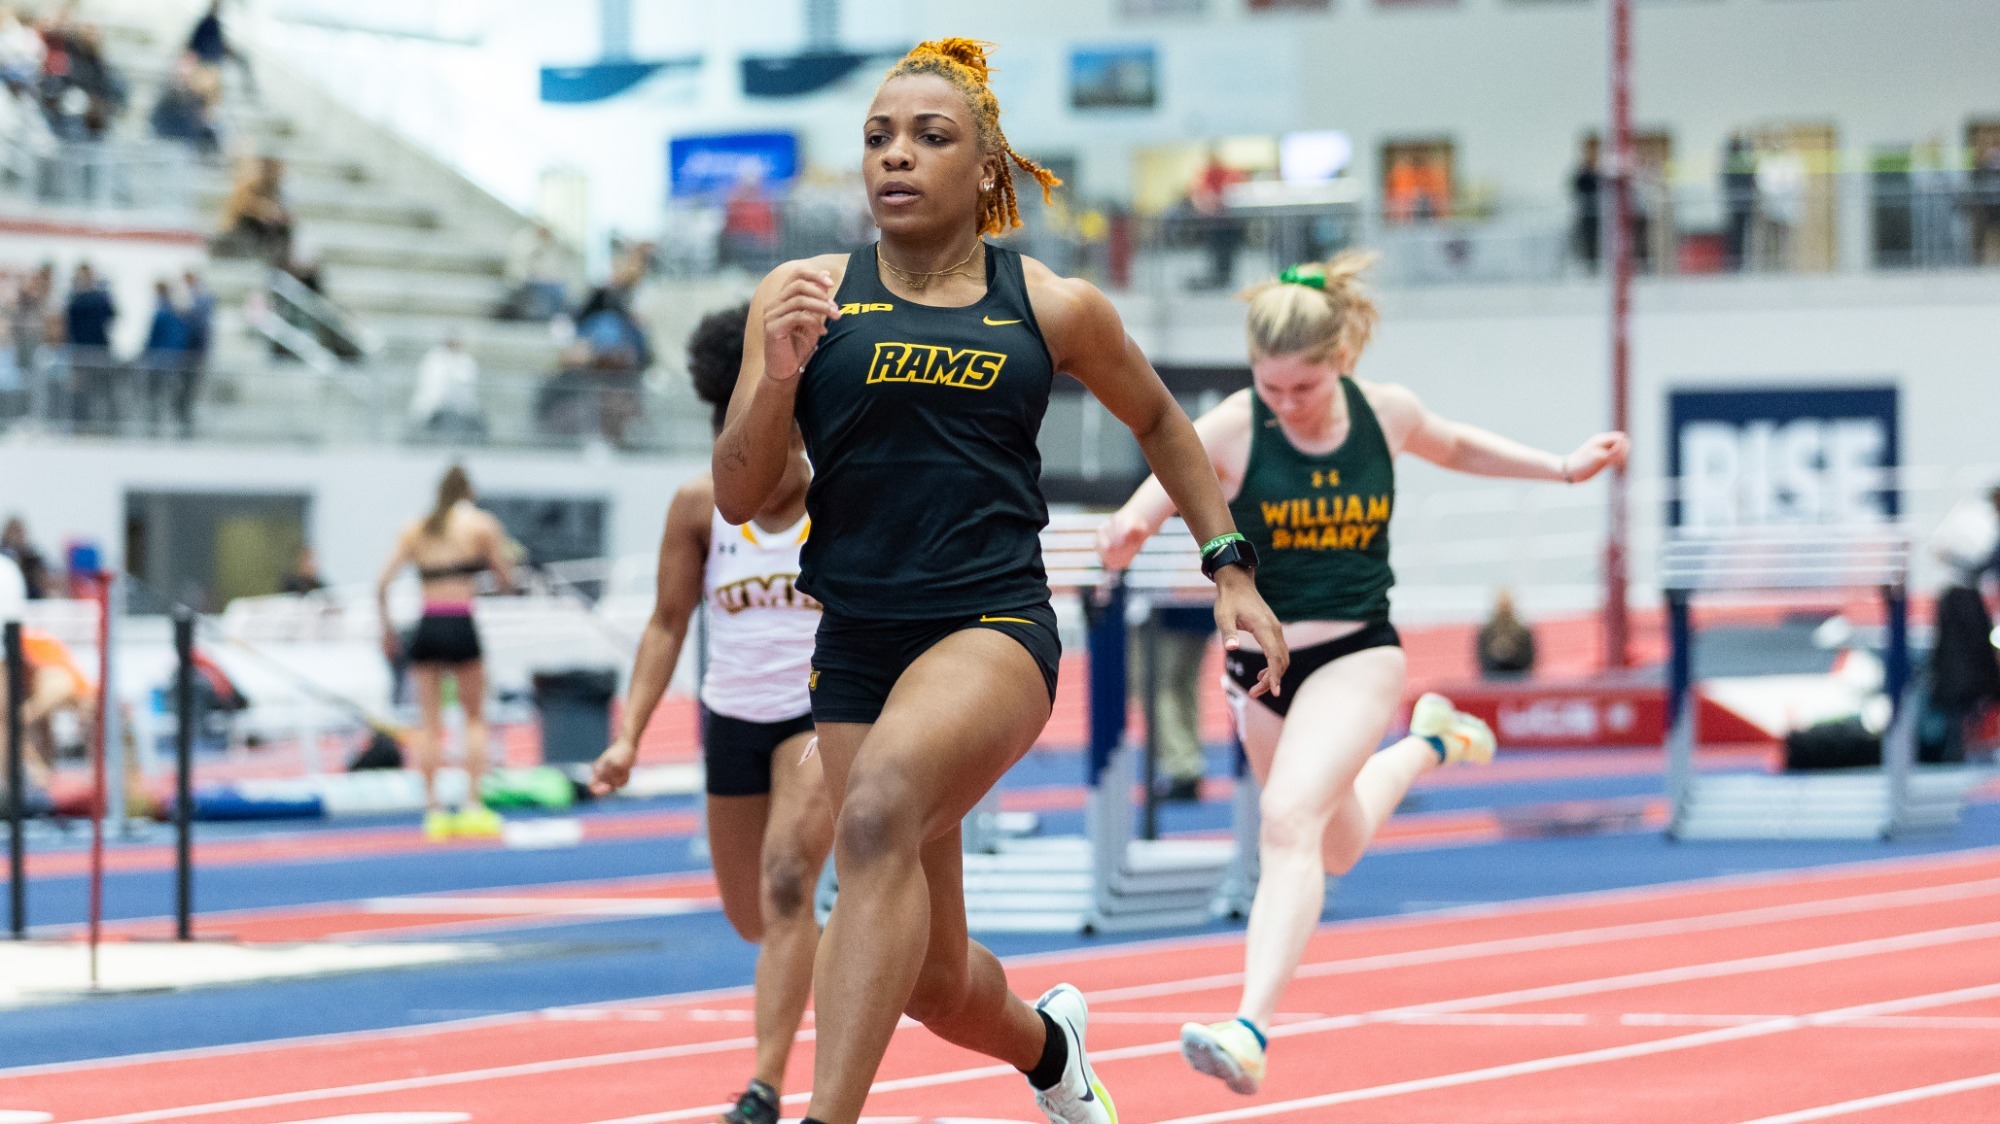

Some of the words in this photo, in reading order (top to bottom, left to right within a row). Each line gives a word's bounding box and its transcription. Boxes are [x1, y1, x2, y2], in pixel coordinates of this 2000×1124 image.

[866, 342, 1008, 391] RAMS
[1680, 416, 1886, 532] RISE
[1260, 494, 1390, 528] WILLIAM
